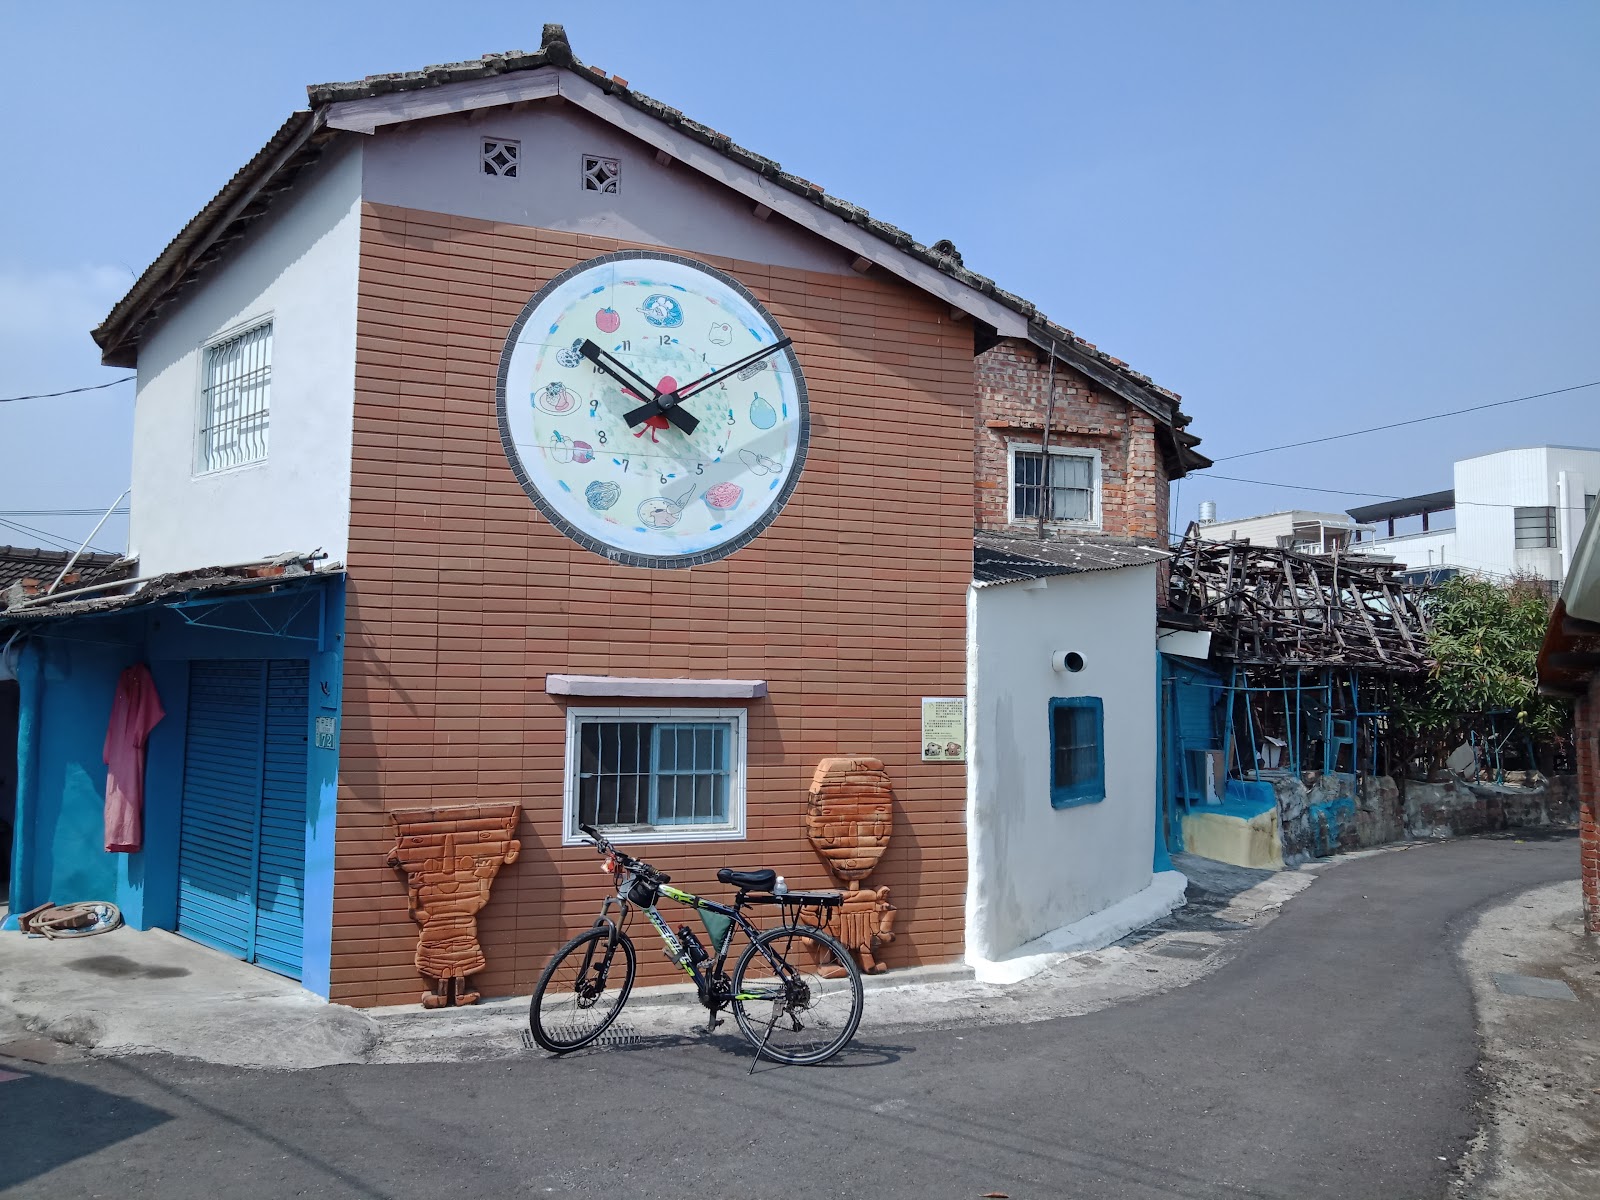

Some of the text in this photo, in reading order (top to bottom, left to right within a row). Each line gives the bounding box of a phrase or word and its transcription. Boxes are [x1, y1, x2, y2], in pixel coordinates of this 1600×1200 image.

[621, 340, 631, 351] 11
[659, 335, 671, 345] 12
[702, 353, 706, 362] 1
[719, 382, 727, 391] 2
[590, 399, 598, 412] 9
[727, 414, 735, 426] 3
[598, 430, 607, 444] 8
[717, 445, 724, 454] 4
[622, 459, 629, 473] 7
[695, 463, 704, 475] 5
[660, 473, 667, 485] 6
[321, 733, 332, 747] 72
